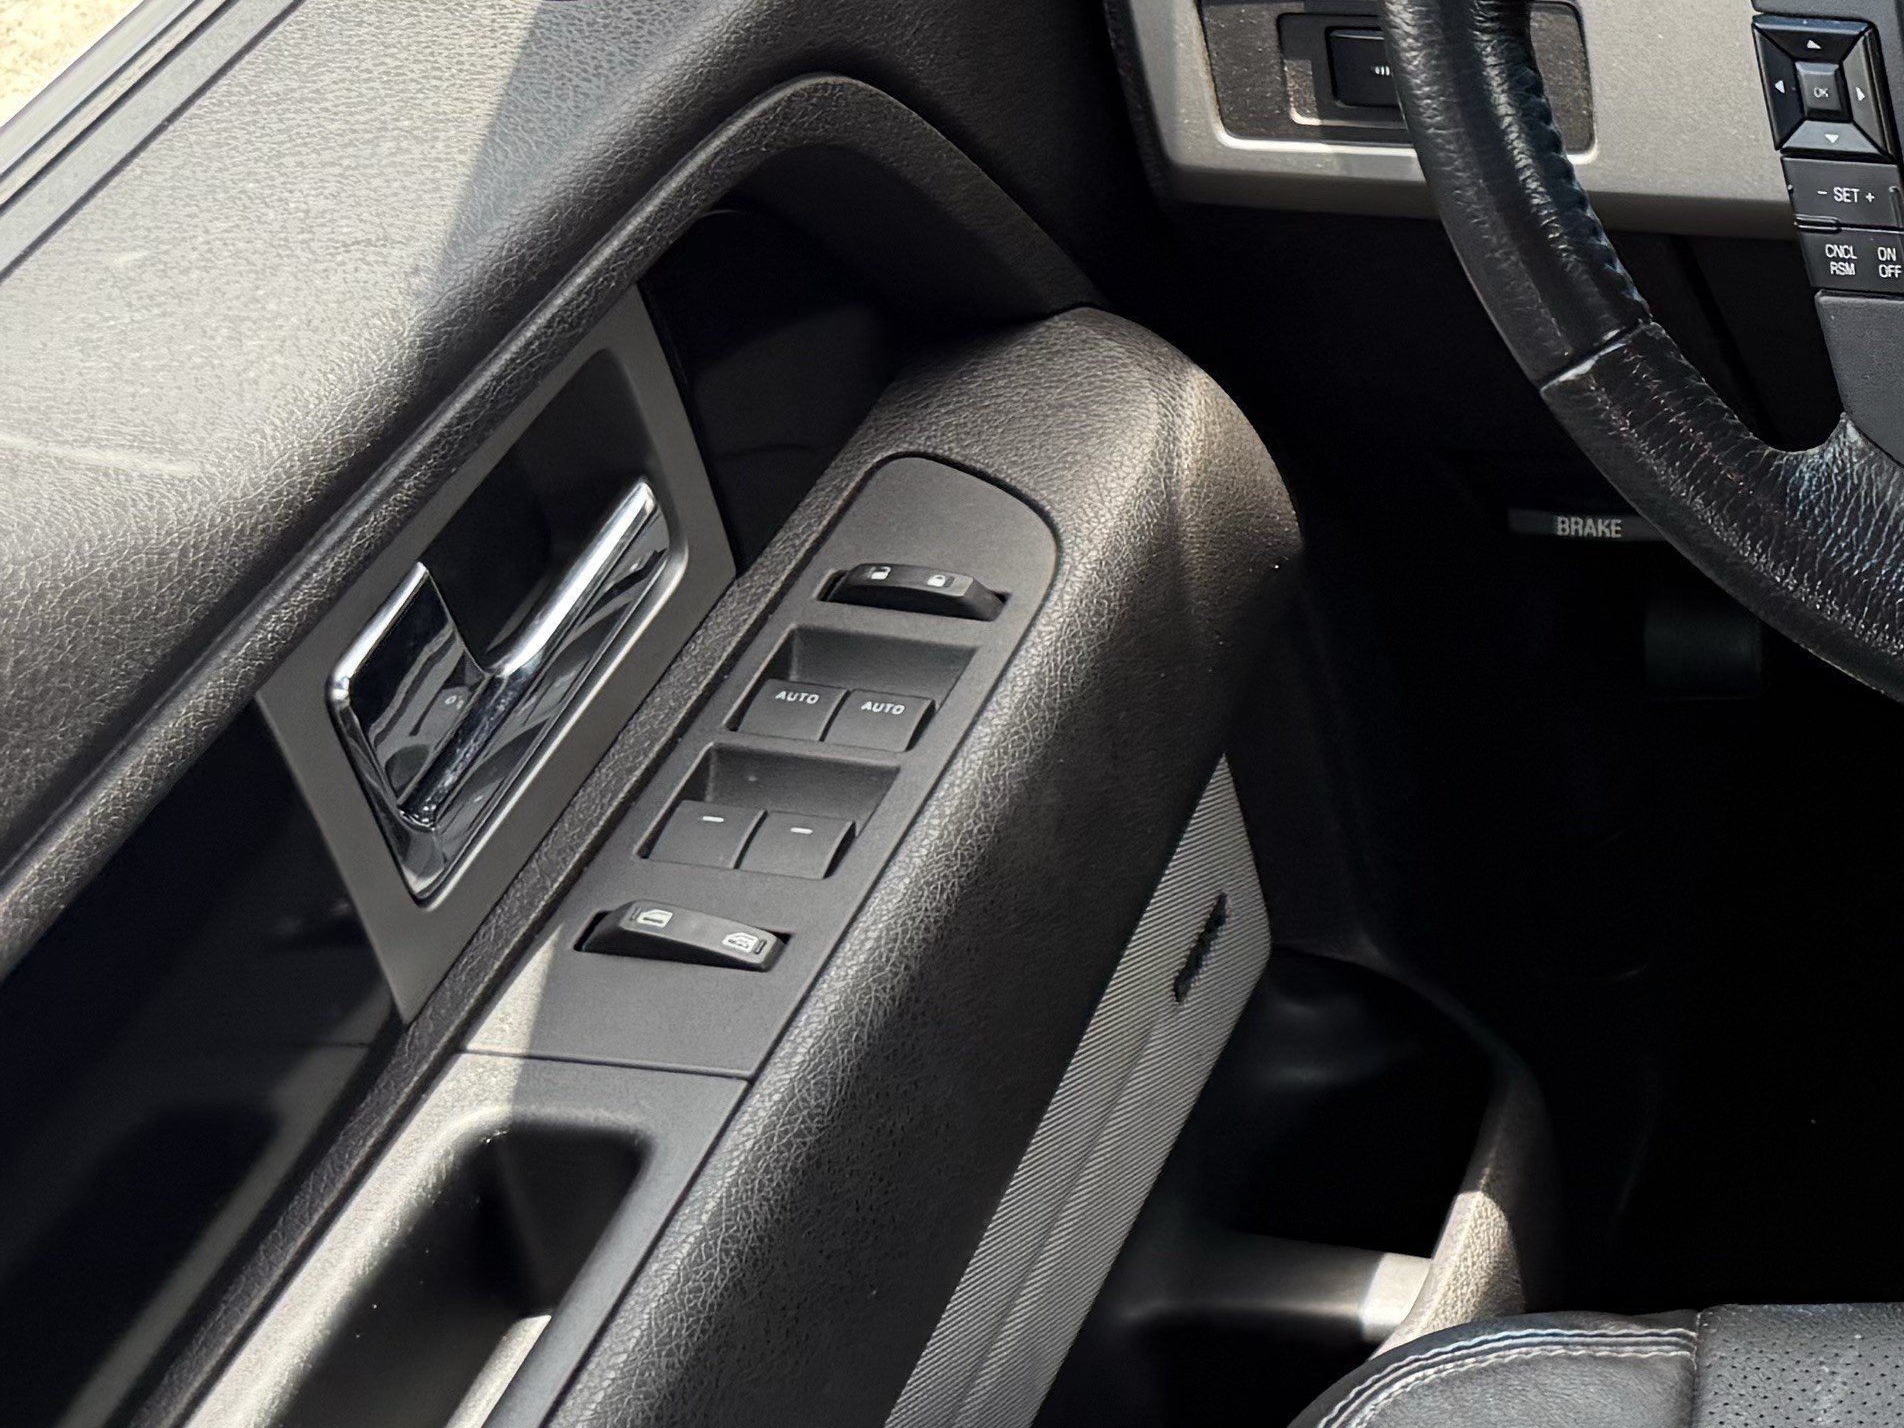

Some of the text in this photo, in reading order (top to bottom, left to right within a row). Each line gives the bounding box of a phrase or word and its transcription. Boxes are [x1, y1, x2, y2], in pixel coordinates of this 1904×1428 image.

[1813, 87, 1829, 98] OK
[1833, 186, 1860, 203] SET
[1825, 244, 1857, 259] CNCL
[1878, 246, 1896, 262] ON
[1830, 261, 1855, 276] RSM
[1878, 264, 1902, 278] OFF
[1555, 516, 1622, 539] BRAKE
[775, 689, 820, 705] AUTO
[861, 700, 905, 716] AUTO
